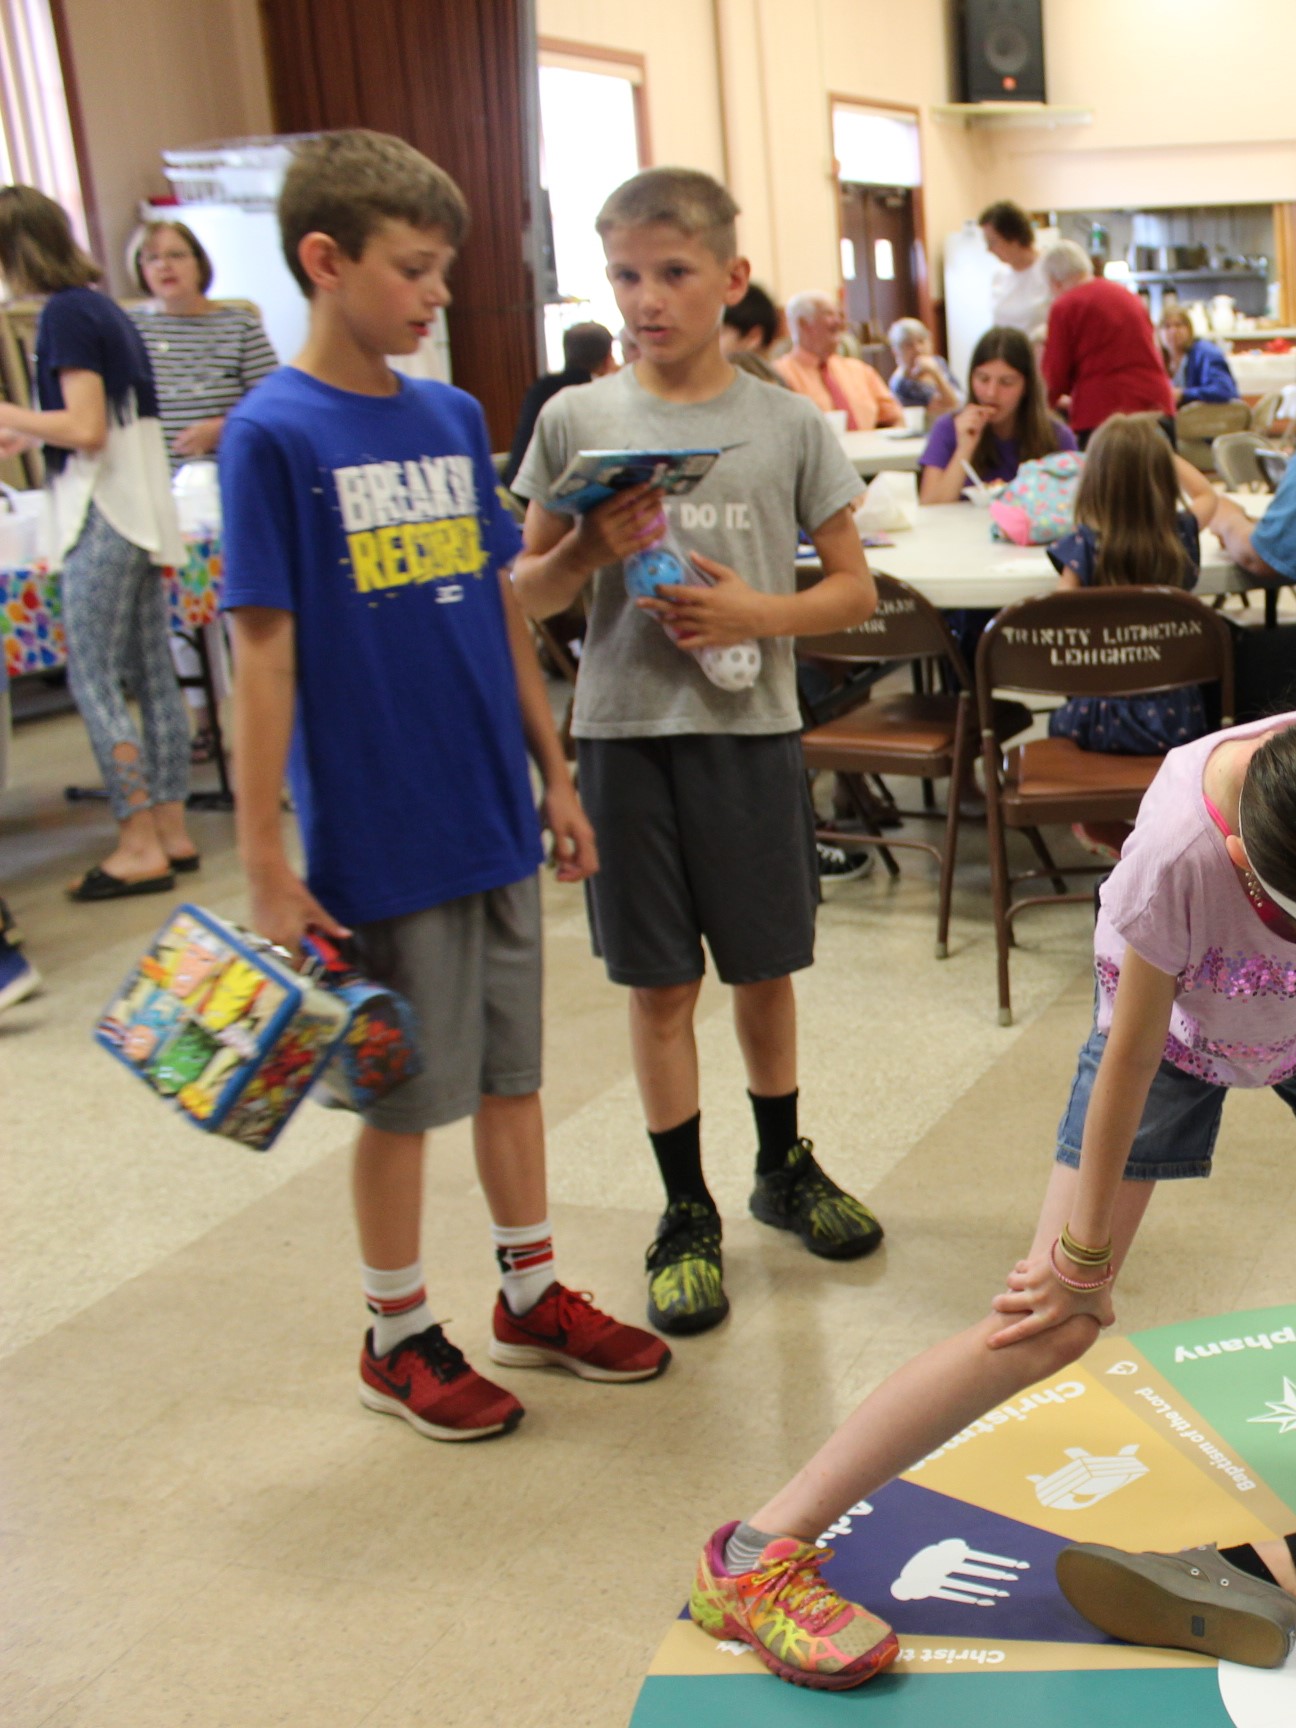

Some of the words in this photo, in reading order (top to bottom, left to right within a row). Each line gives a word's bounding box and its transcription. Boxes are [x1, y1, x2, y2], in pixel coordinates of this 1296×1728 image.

[680, 502, 717, 529] DO
[725, 502, 751, 529] IT.
[1002, 626, 1091, 646] TRINITY
[1103, 620, 1202, 645] LUTHERAN
[1134, 1386, 1172, 1414] Lord
[1165, 1410, 1192, 1432] the
[1179, 1430, 1206, 1443] of
[1198, 1441, 1257, 1492] Baptism
[920, 1648, 1006, 1665] Christ
